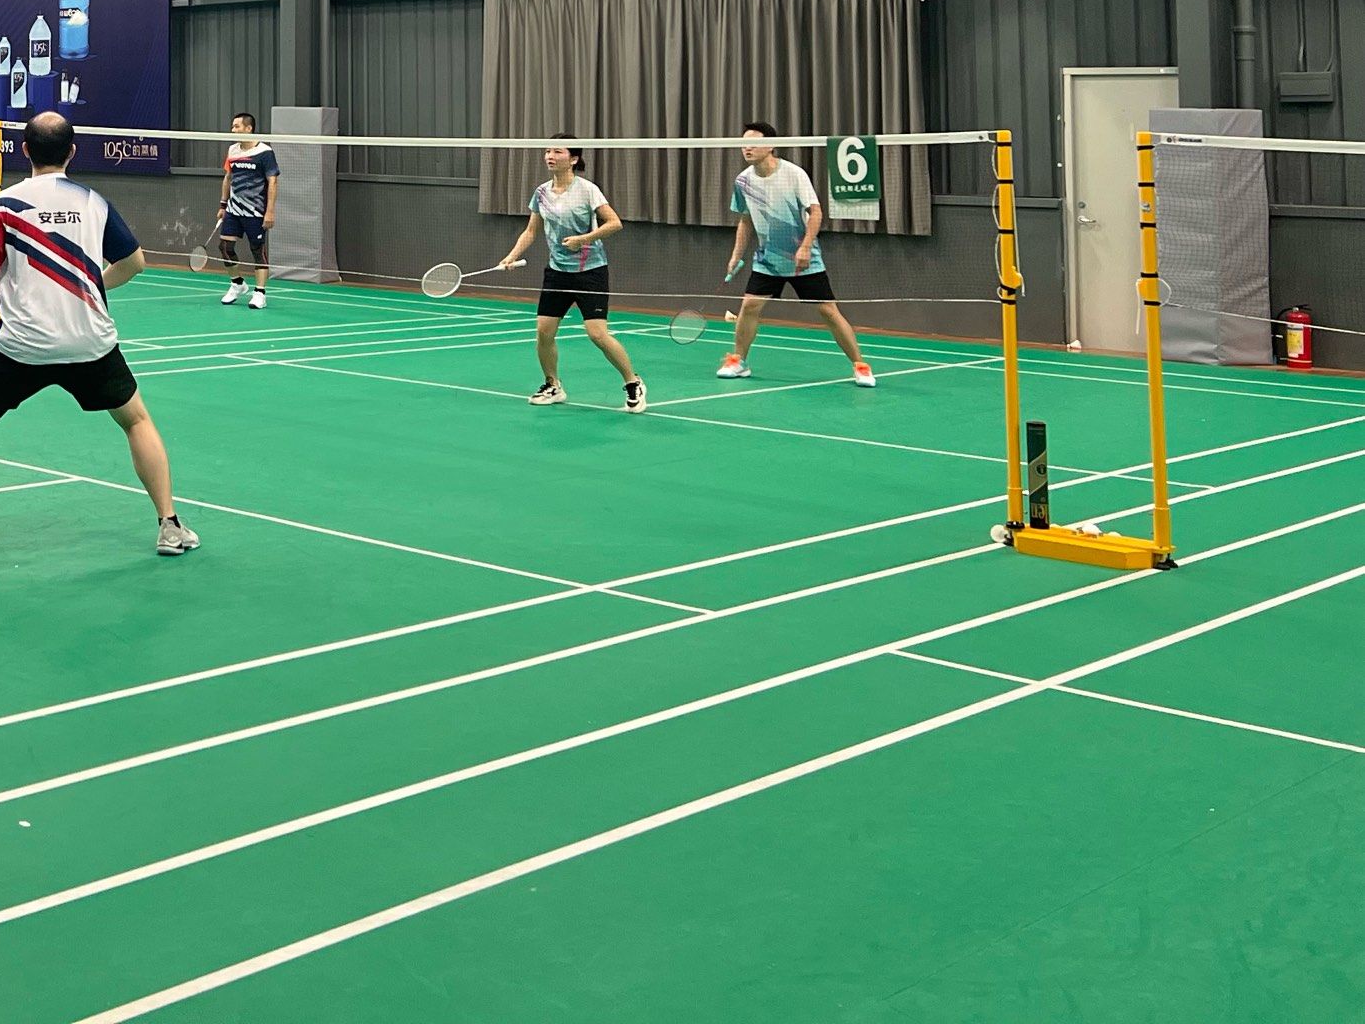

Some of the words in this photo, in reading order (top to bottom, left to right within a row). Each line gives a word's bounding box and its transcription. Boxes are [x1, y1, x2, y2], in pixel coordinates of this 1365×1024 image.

[837, 137, 868, 183] 6
[38, 211, 82, 224] 安吉尔
